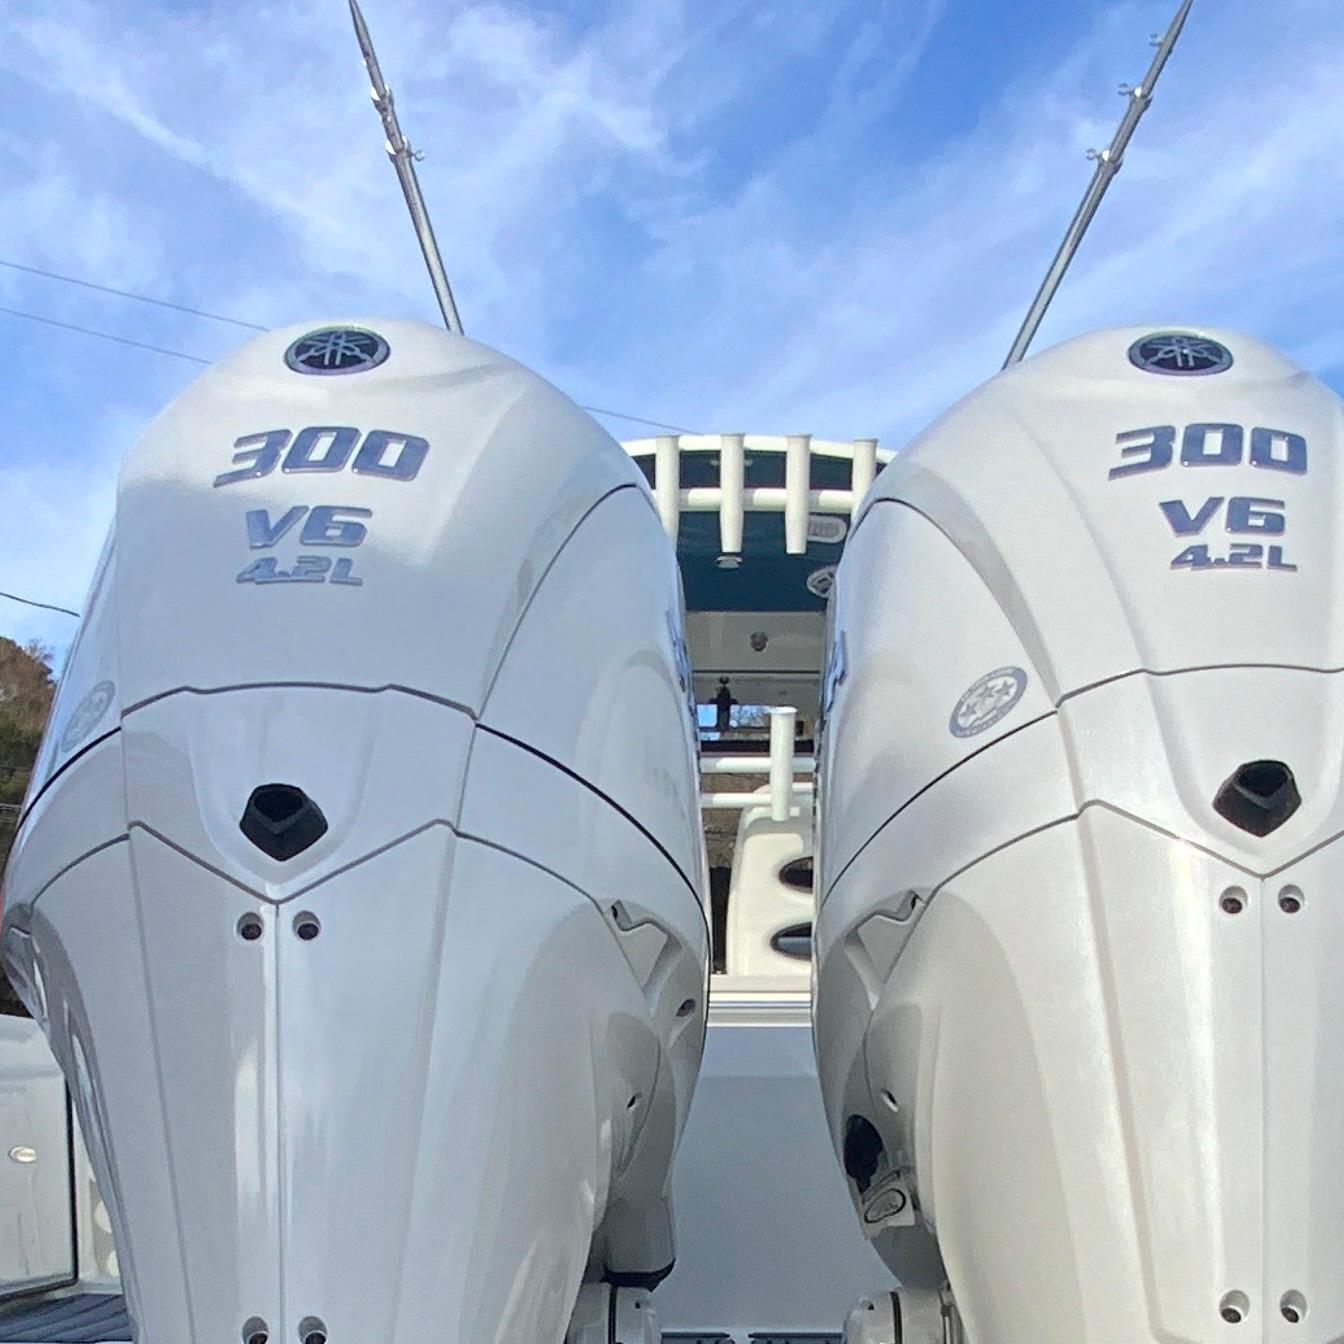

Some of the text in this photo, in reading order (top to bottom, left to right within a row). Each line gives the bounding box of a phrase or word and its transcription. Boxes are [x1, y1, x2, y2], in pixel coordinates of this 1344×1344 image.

[213, 426, 430, 488] 300
[1108, 423, 1308, 480] 300
[245, 504, 372, 550] V6
[1158, 496, 1286, 536] V6
[236, 555, 364, 587] 4.2L
[1169, 543, 1297, 572] 4.2L
